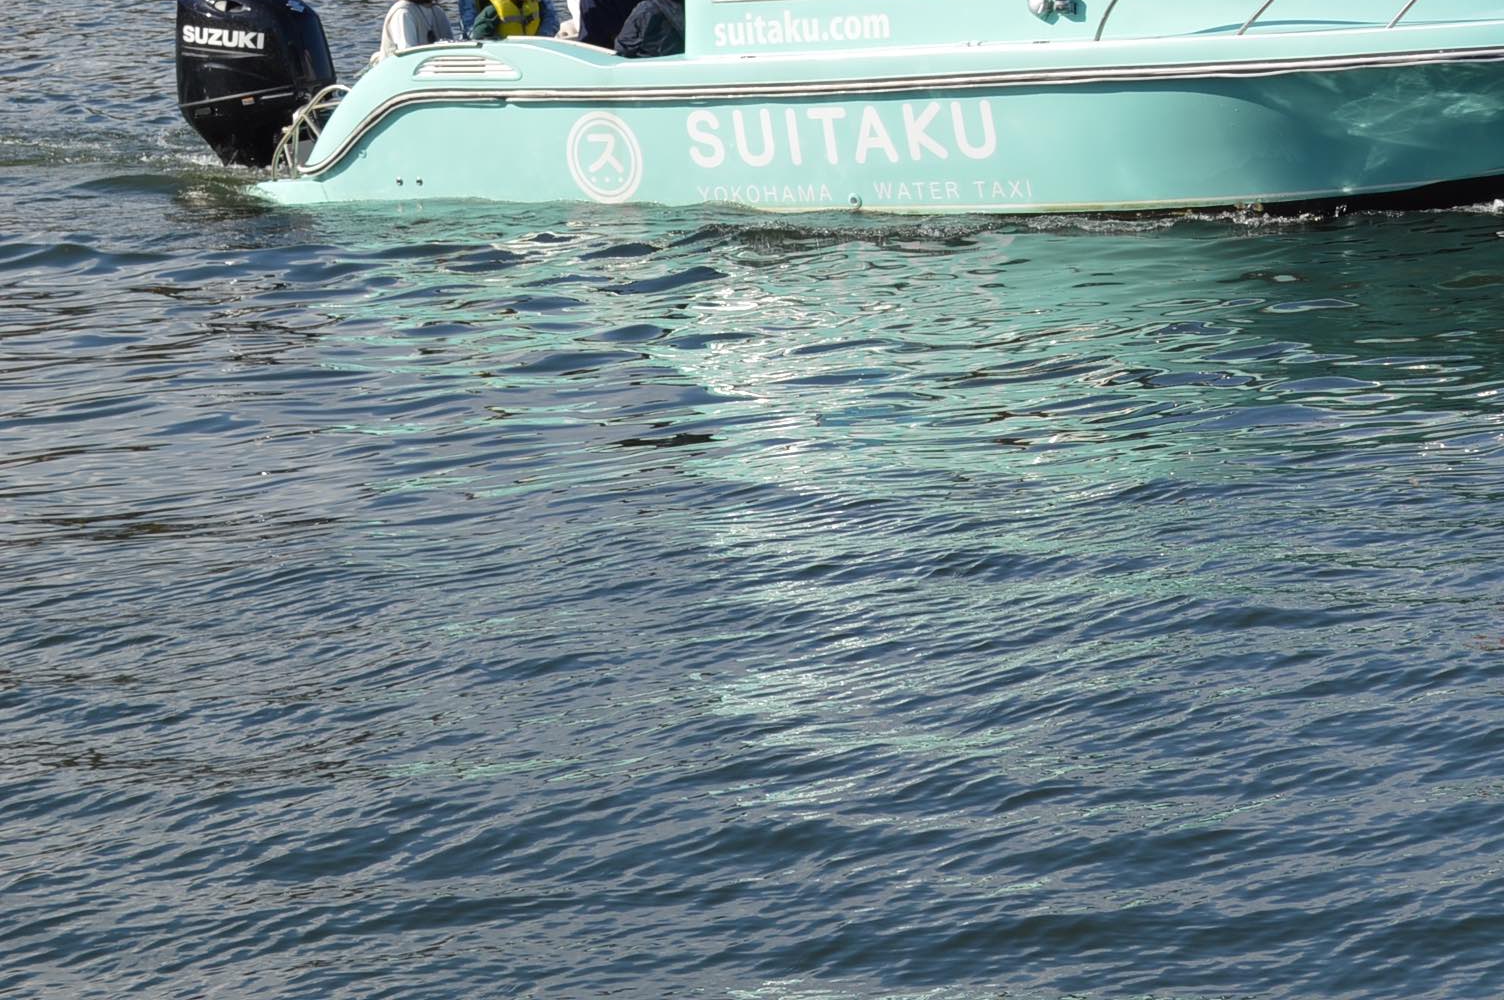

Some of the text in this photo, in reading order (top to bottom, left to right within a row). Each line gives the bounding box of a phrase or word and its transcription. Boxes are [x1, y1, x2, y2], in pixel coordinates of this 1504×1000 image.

[182, 25, 264, 50] SUZUKI
[714, 9, 891, 47] suitaku.com
[686, 99, 997, 168] SUITAKU
[586, 133, 625, 174] ス
[697, 179, 1033, 204] YOKOHAMA WATER TAXI
